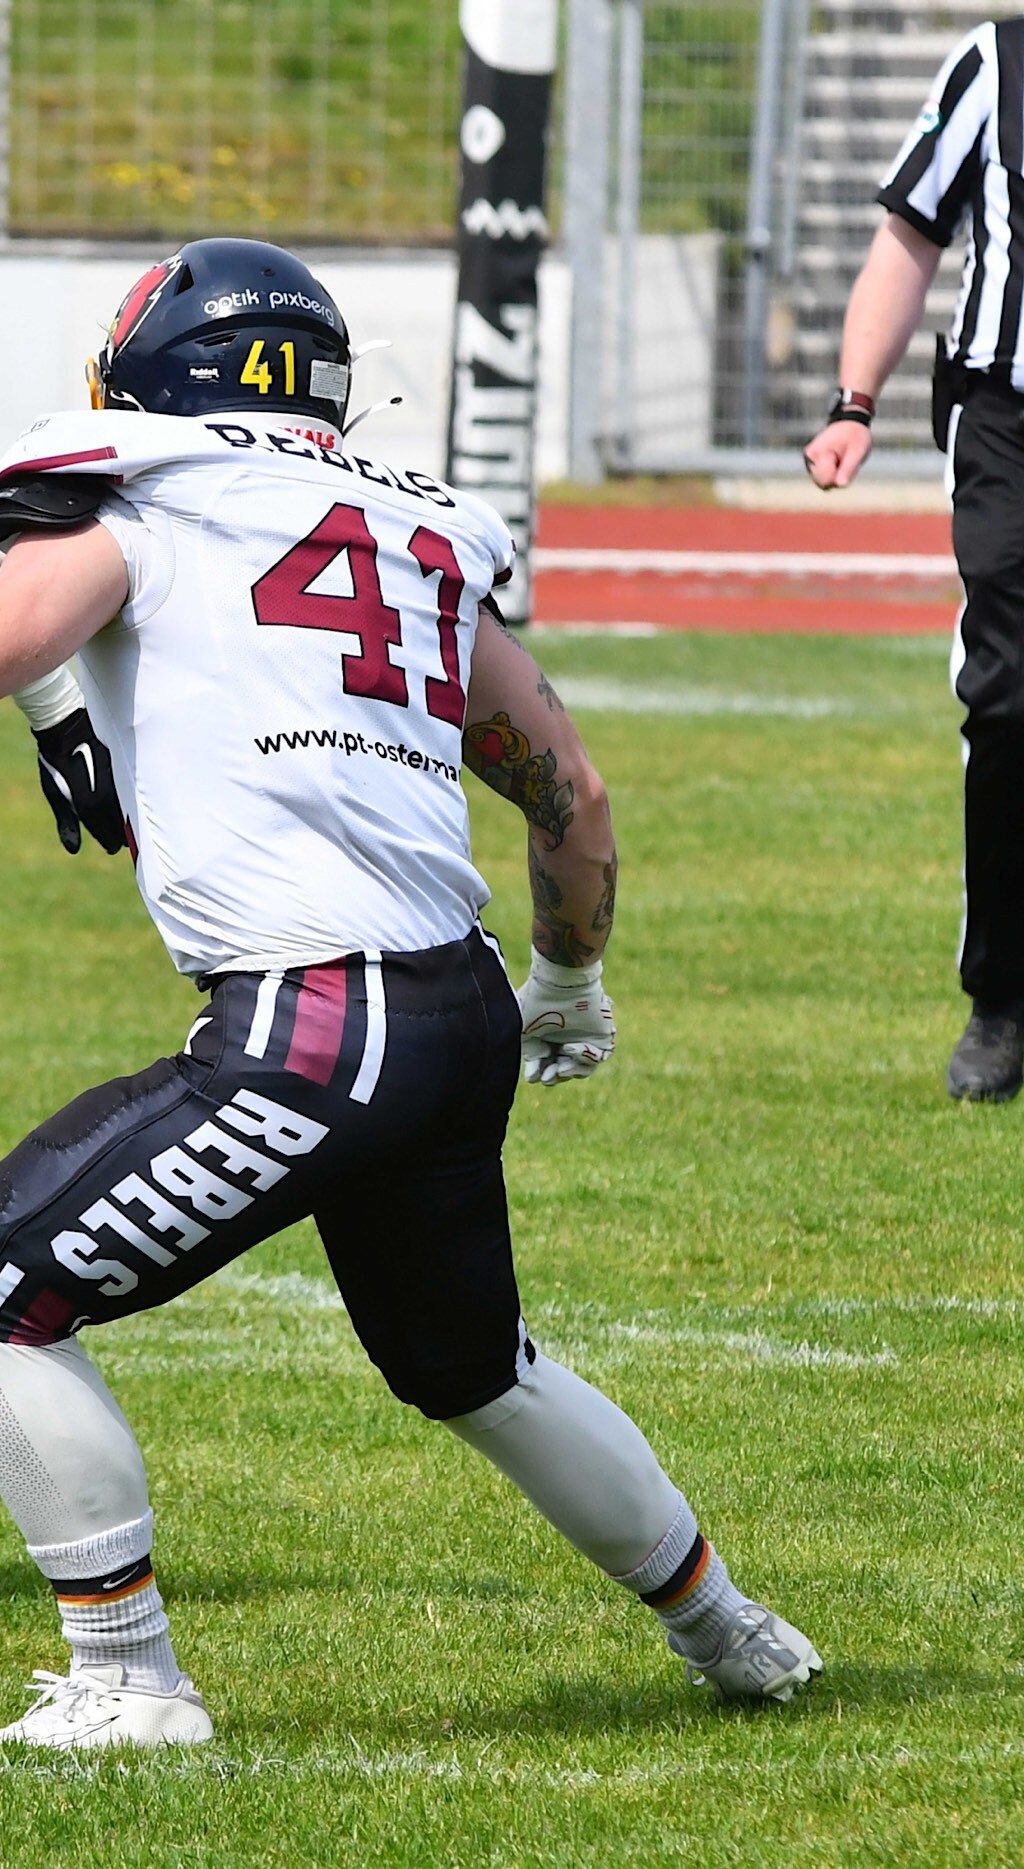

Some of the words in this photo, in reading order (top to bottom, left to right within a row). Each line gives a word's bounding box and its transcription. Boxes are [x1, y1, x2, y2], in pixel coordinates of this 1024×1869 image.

[204, 289, 260, 317] optik
[269, 291, 334, 327] pixberg
[240, 340, 295, 395] 41
[251, 501, 467, 731] 41
[49, 1088, 331, 1297] REBELS
